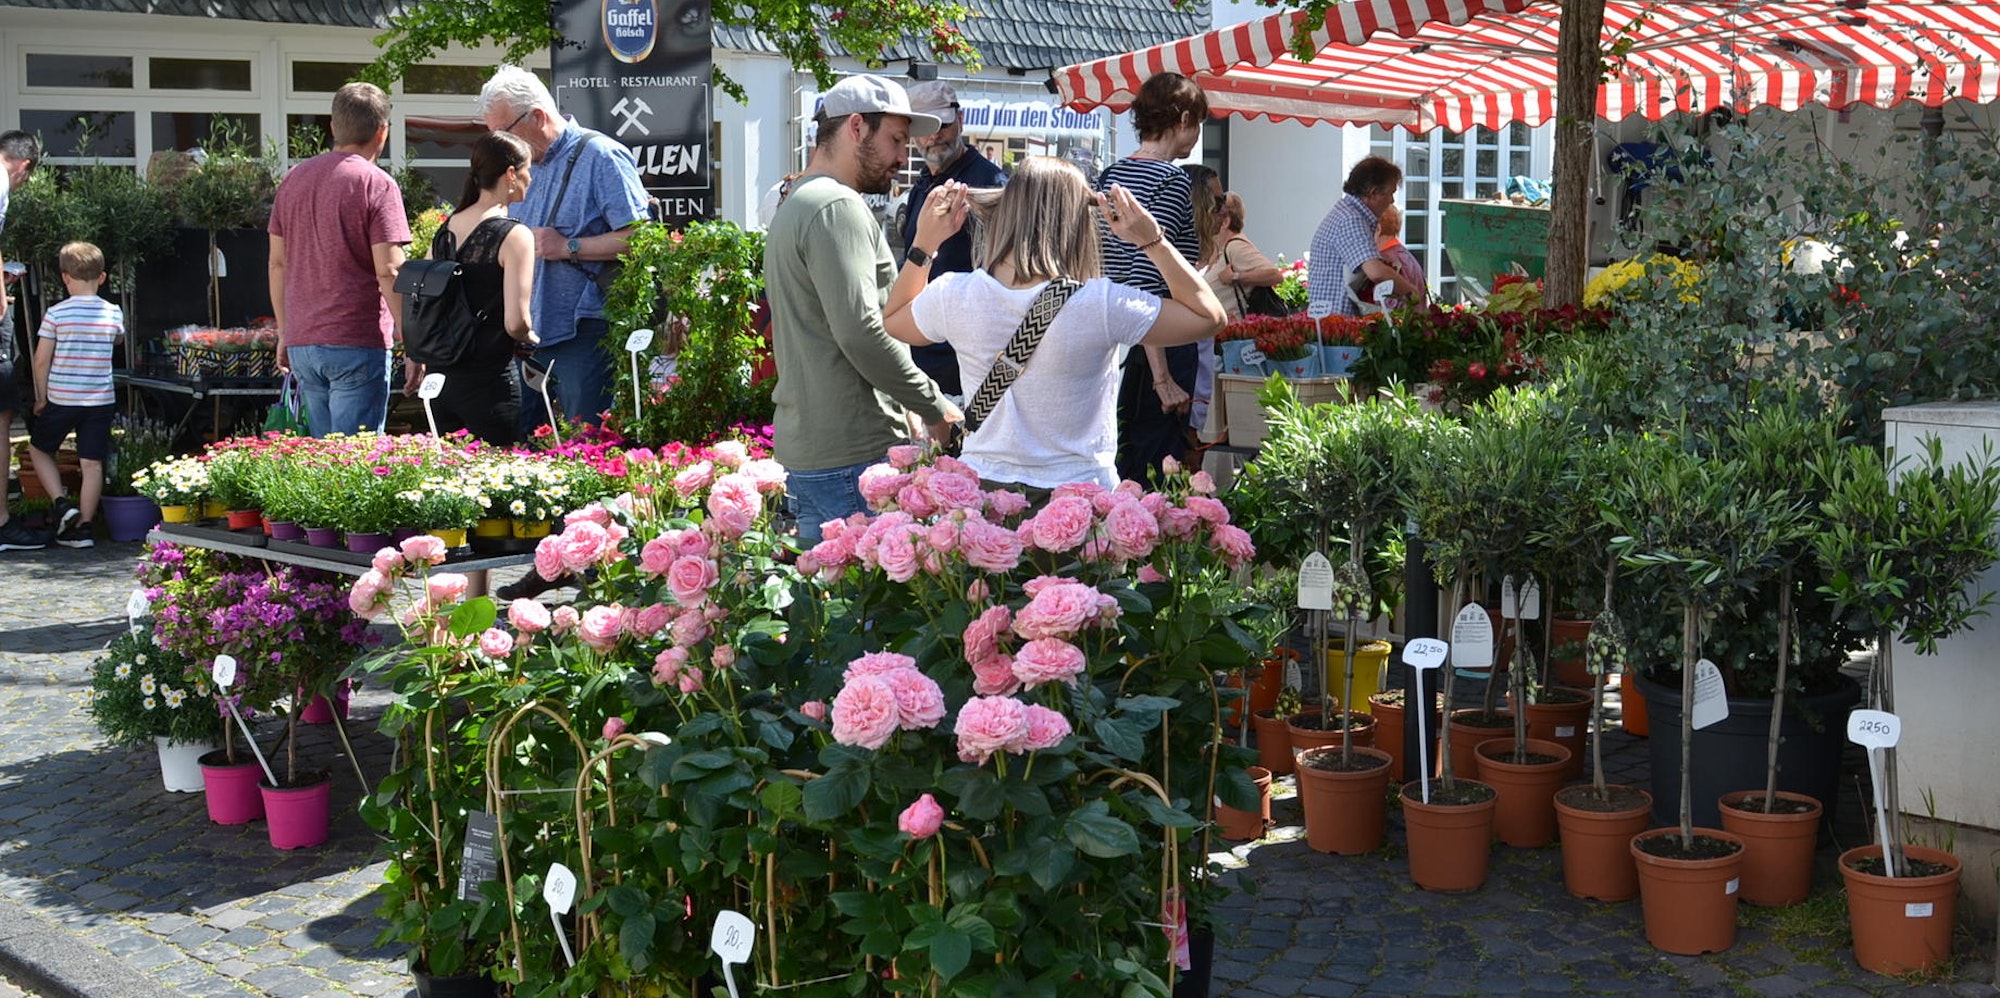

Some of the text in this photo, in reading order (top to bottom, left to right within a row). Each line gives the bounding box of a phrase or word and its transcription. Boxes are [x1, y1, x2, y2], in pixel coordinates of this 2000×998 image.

[608, 8, 652, 27] Gaffel
[569, 76, 698, 88] HOTEL RESTAURANT
[994, 108, 1017, 127] um
[1020, 107, 1047, 127] den
[1051, 108, 1101, 130] Stollen
[632, 144, 701, 176] LLEN
